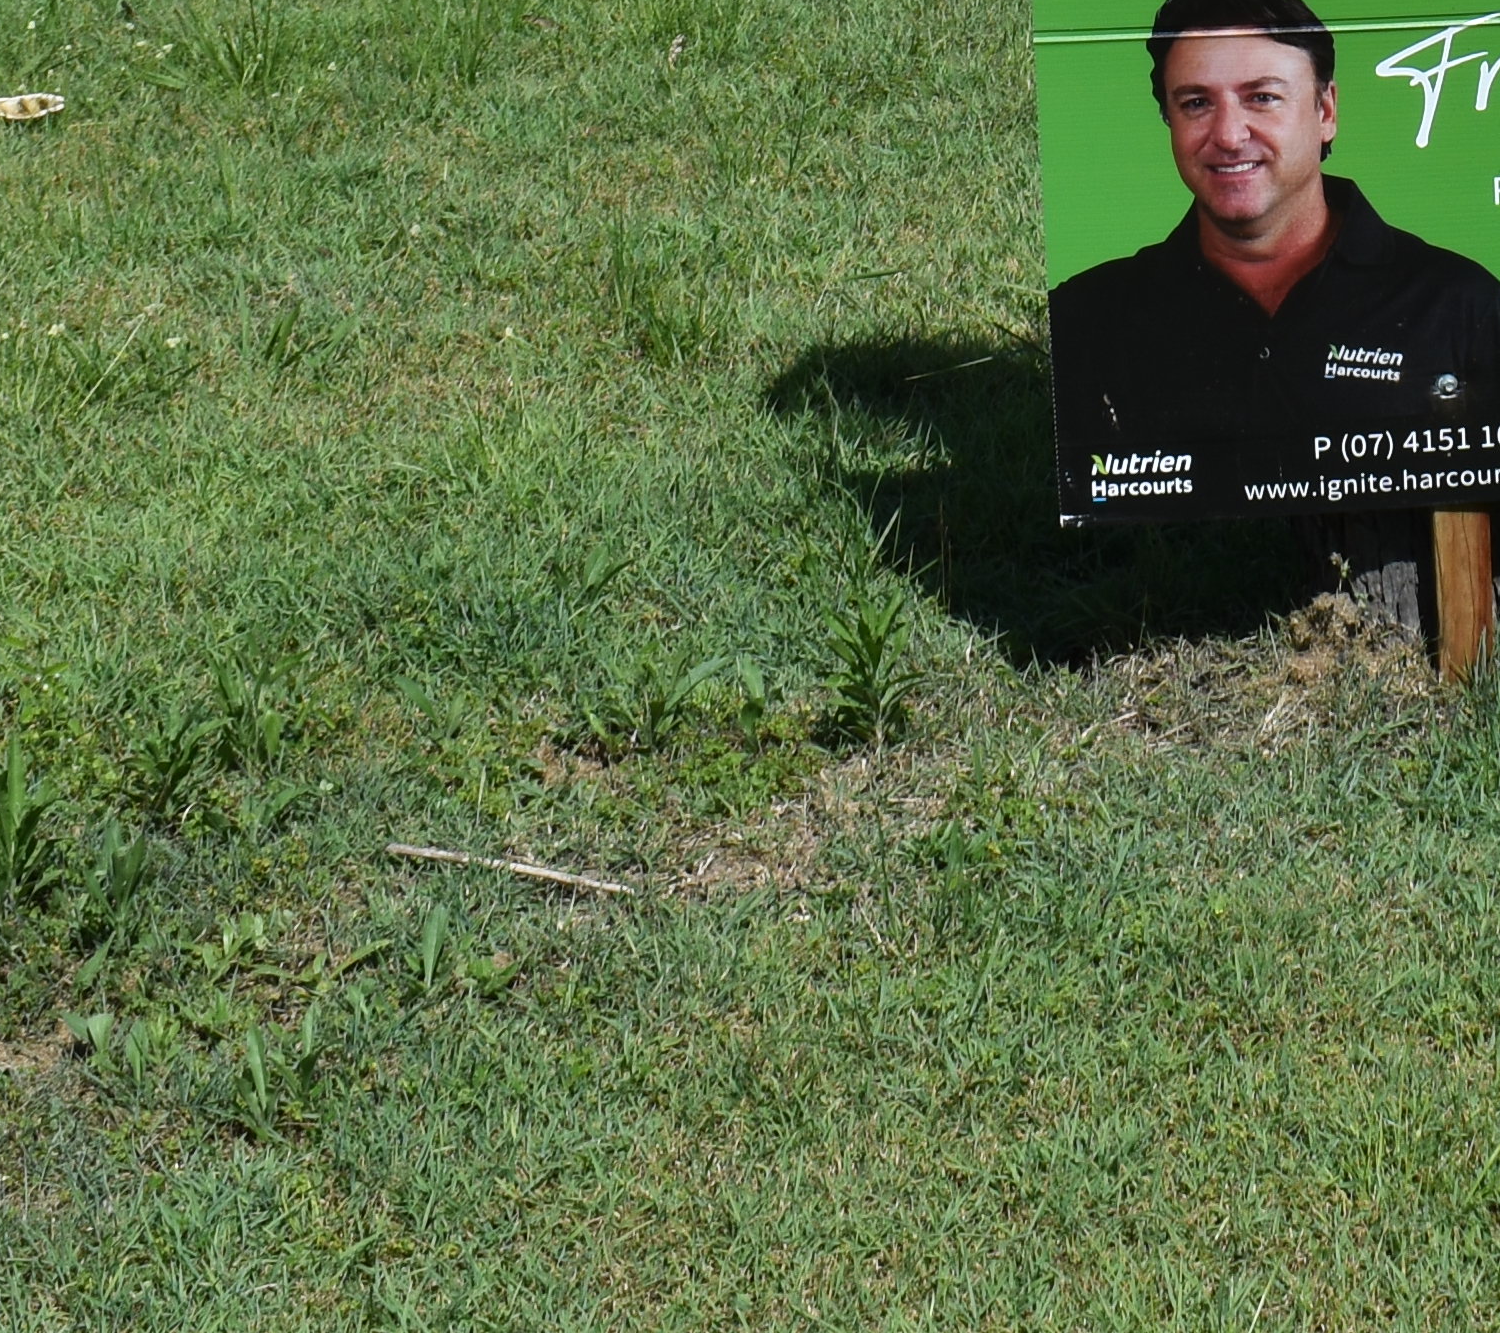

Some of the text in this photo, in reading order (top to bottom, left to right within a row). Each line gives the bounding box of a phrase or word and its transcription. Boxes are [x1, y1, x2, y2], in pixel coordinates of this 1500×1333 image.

[1327, 343, 1404, 367] Nutrien
[1324, 362, 1401, 382] Harcourts
[1312, 435, 1332, 461] P
[1341, 430, 1395, 463] (07)
[1402, 426, 1471, 455] 4151
[1090, 449, 1193, 477] Nutrien
[1091, 476, 1194, 498] Harcourts
